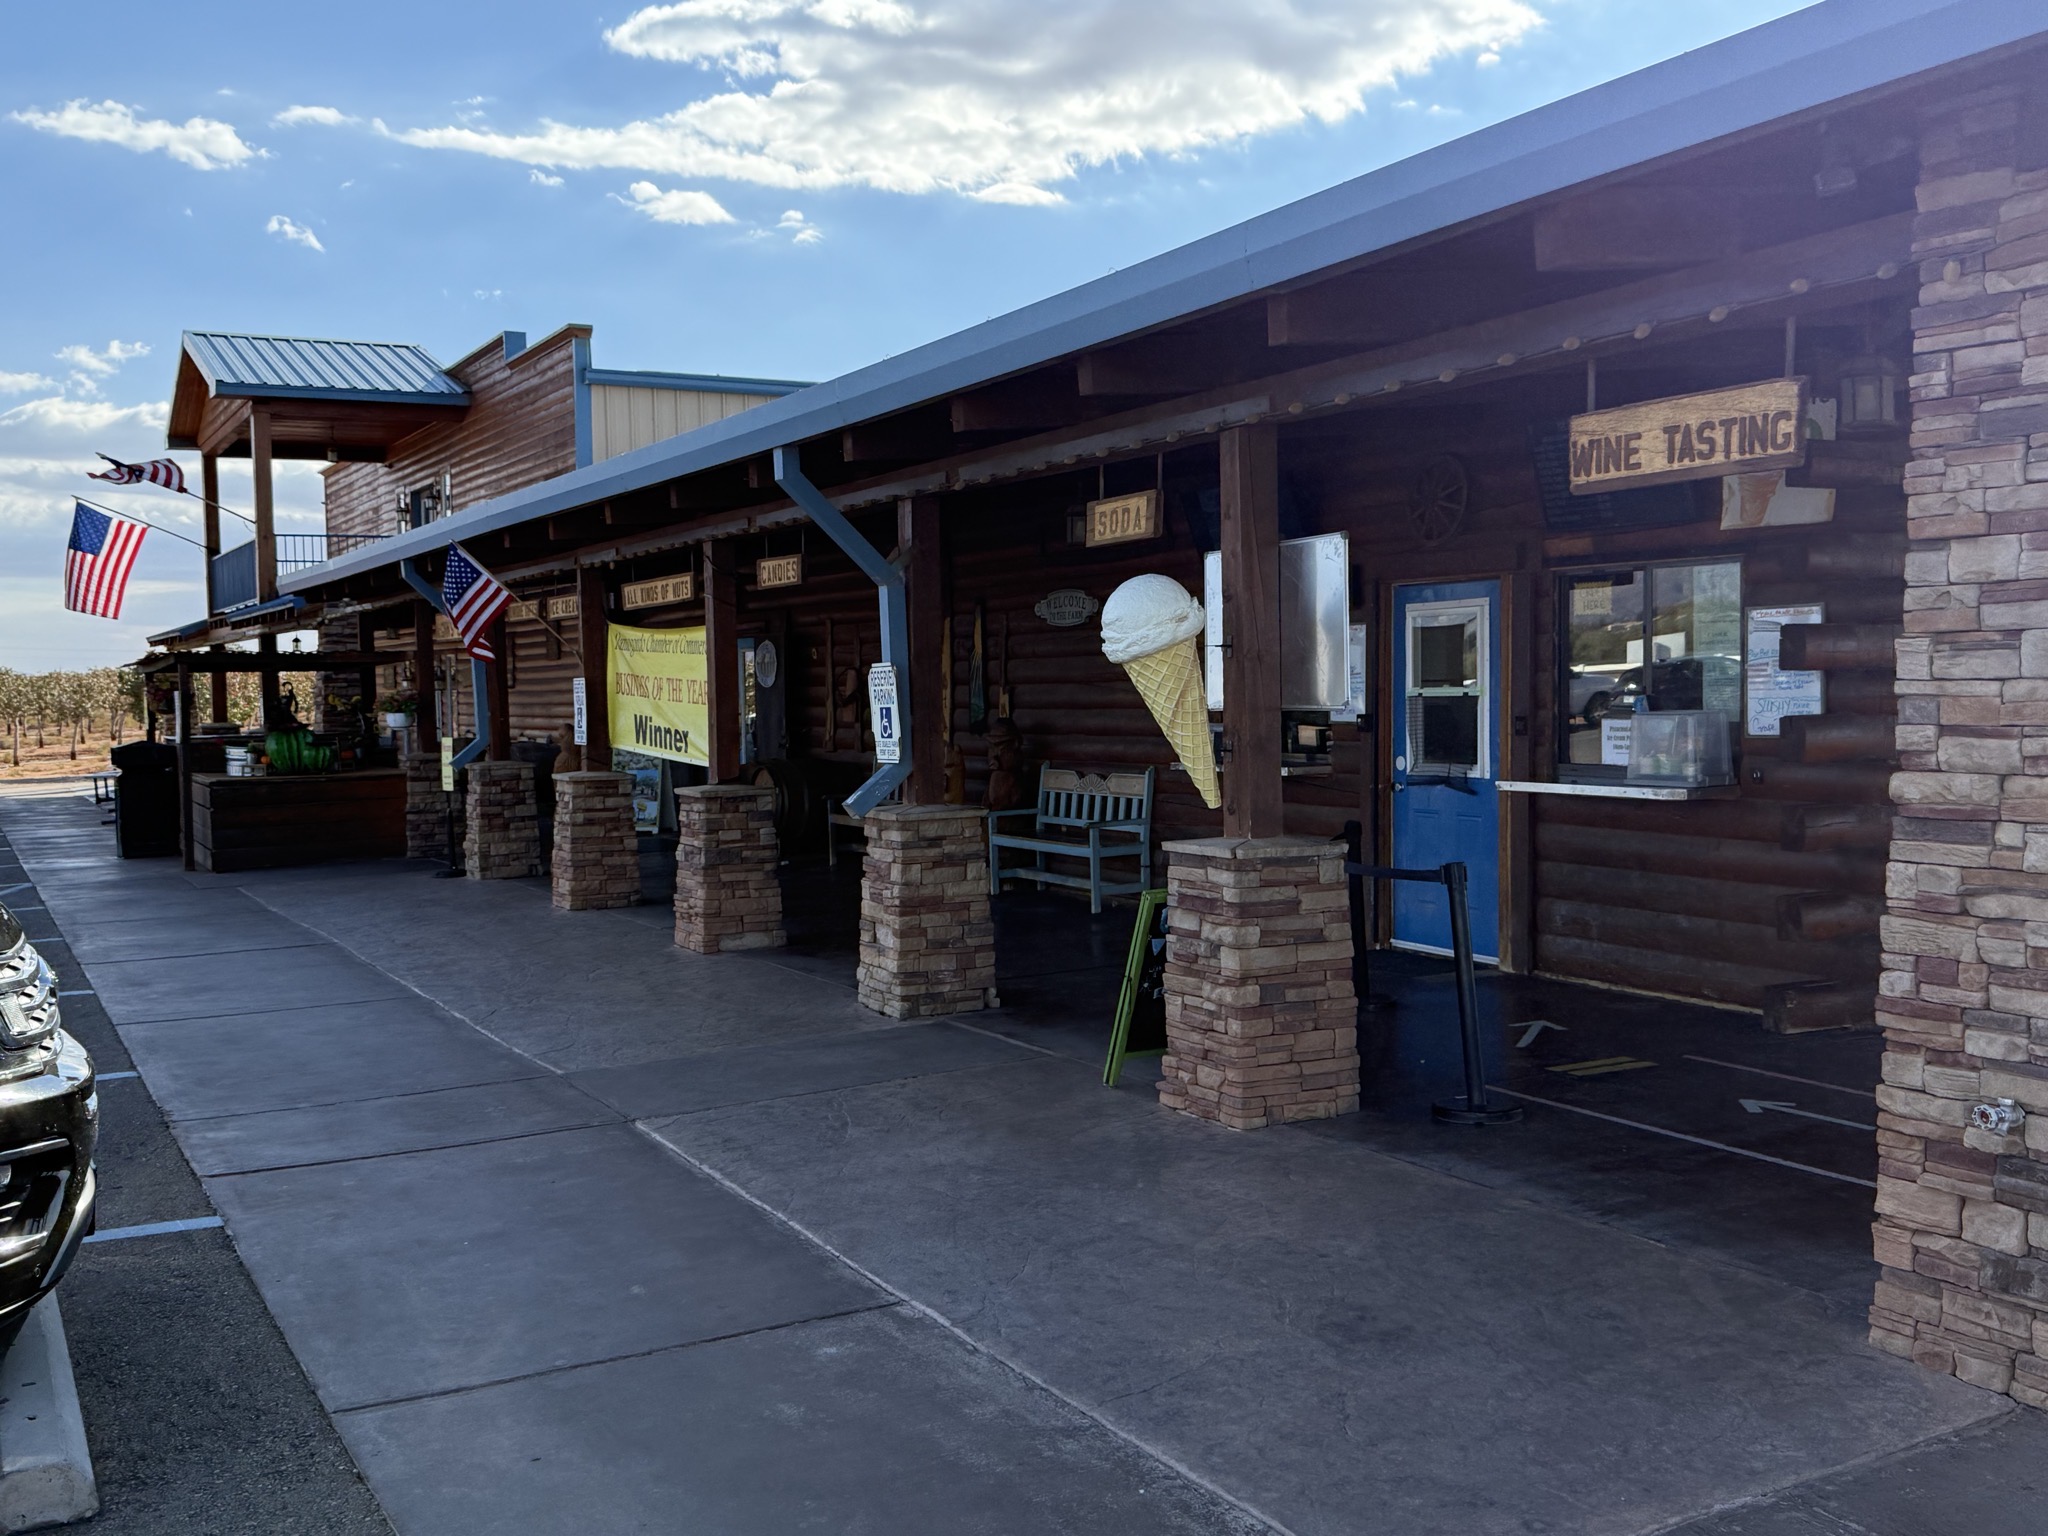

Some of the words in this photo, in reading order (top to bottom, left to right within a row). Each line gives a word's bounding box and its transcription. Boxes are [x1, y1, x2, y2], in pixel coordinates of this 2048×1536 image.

[1571, 432, 1642, 478] WINE
[1662, 411, 1793, 465] TASTING
[1097, 505, 1142, 537] SODA
[761, 560, 797, 585] CANDIES
[626, 588, 639, 605] ALL
[640, 585, 659, 603] KINDS
[660, 583, 669, 600] OF
[672, 580, 689, 599] NUTS
[561, 598, 577, 614] CREA
[1046, 595, 1087, 611] WELCOME
[1583, 599, 1606, 611] HERE
[1067, 610, 1083, 620] FARM
[646, 633, 673, 653] Chamber
[615, 671, 650, 699] BUSINESS
[651, 676, 664, 701] OF
[666, 677, 684, 703] THE
[870, 669, 895, 687] RESERVED
[873, 688, 895, 706] PARKING
[1755, 697, 1791, 715] SLUSHY
[633, 713, 689, 754] Winner
